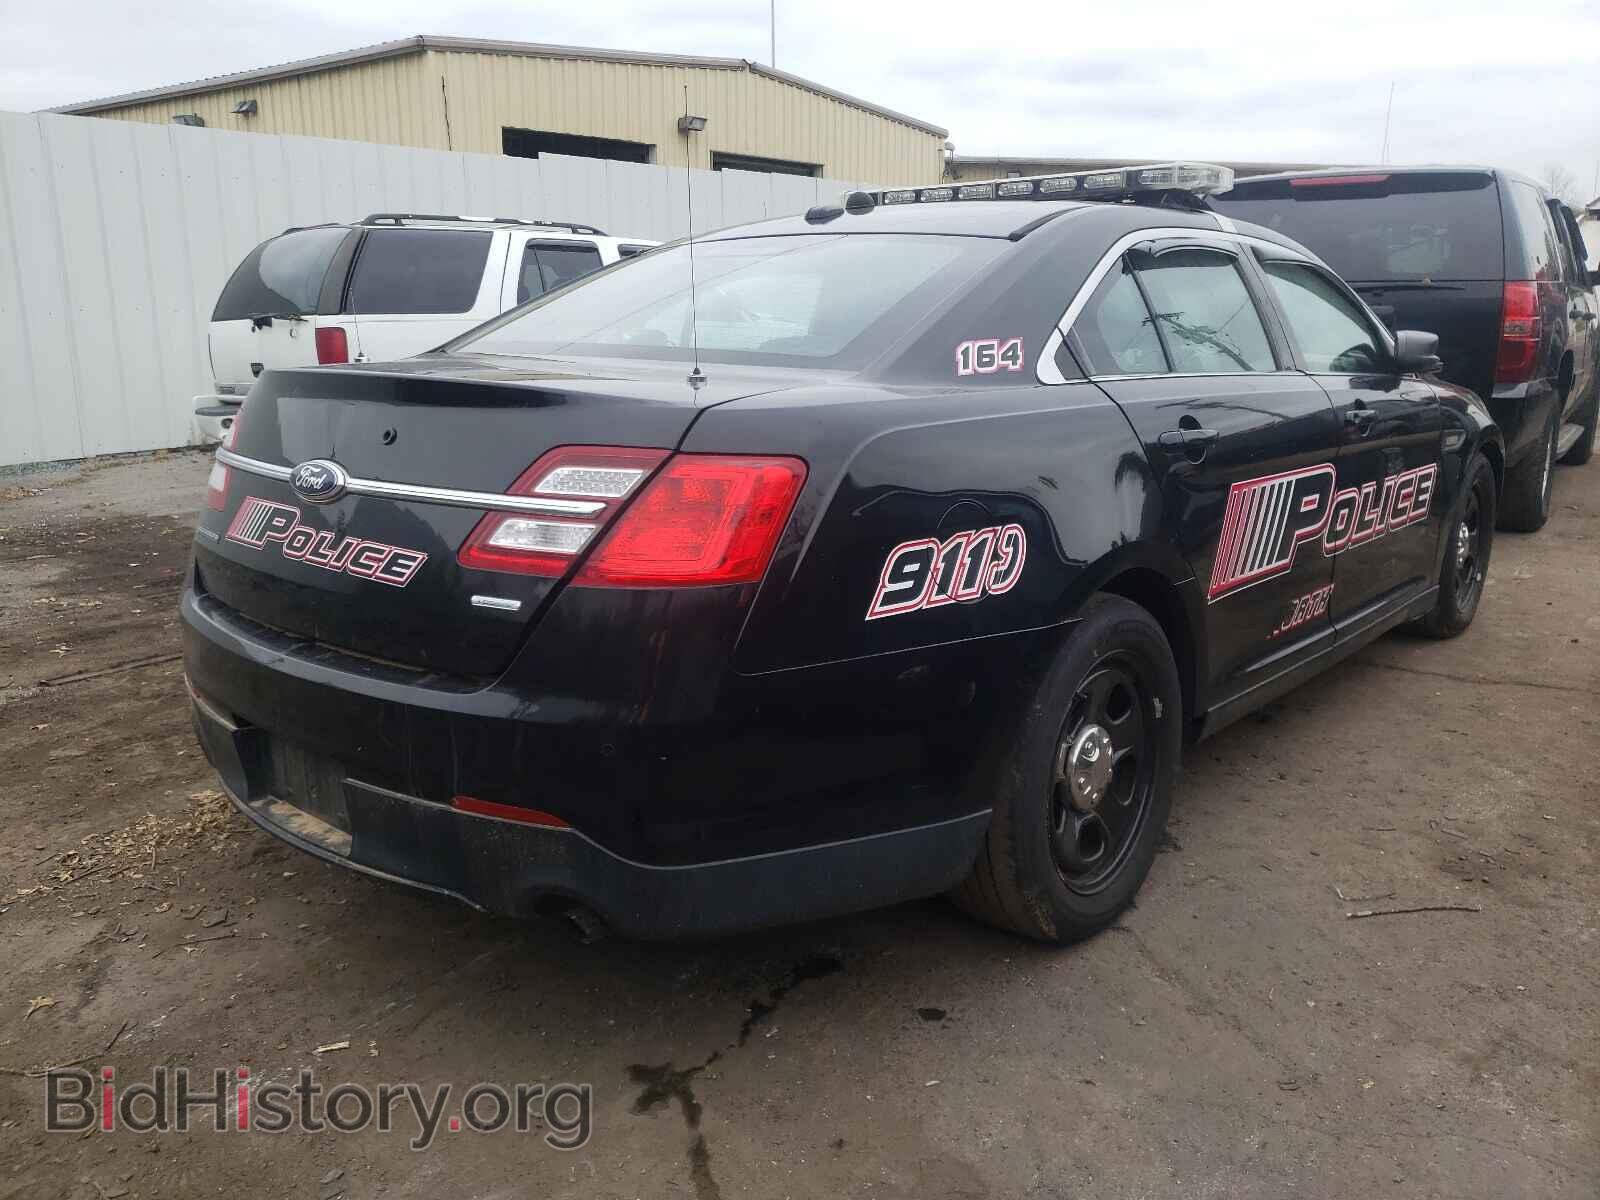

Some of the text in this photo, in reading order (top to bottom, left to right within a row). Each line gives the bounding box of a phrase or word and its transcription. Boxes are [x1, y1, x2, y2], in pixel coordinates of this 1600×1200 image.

[956, 337, 1023, 376] 164
[294, 465, 325, 490] Ford
[225, 495, 429, 588] POLICE
[1207, 462, 1438, 606] POLICE
